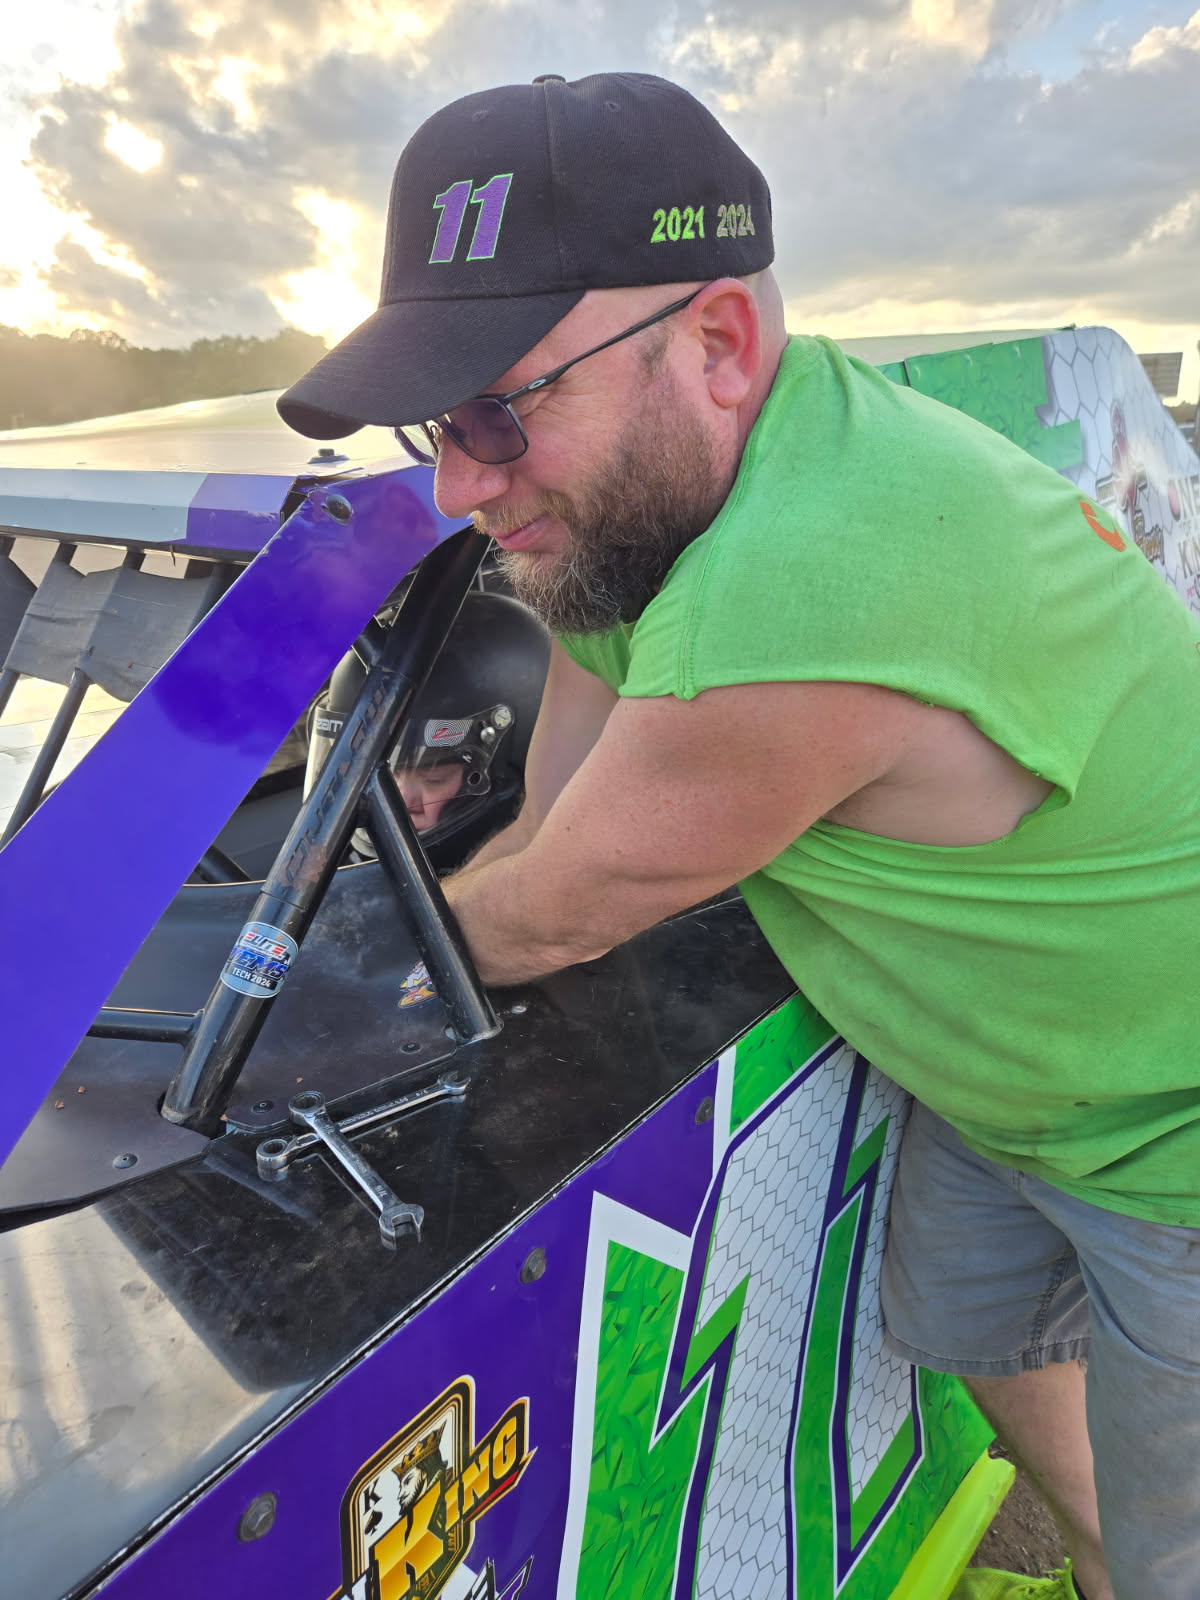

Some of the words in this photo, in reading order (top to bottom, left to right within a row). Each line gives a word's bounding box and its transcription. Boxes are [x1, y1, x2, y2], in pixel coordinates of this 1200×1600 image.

[428, 173, 514, 264] 11
[650, 206, 705, 243] 2021
[716, 204, 755, 239] 2024
[244, 933, 288, 954] ELITE
[233, 968, 251, 980] TECH
[252, 974, 271, 987] 2024
[363, 1475, 382, 1515] K
[374, 1416, 517, 1600] KING
